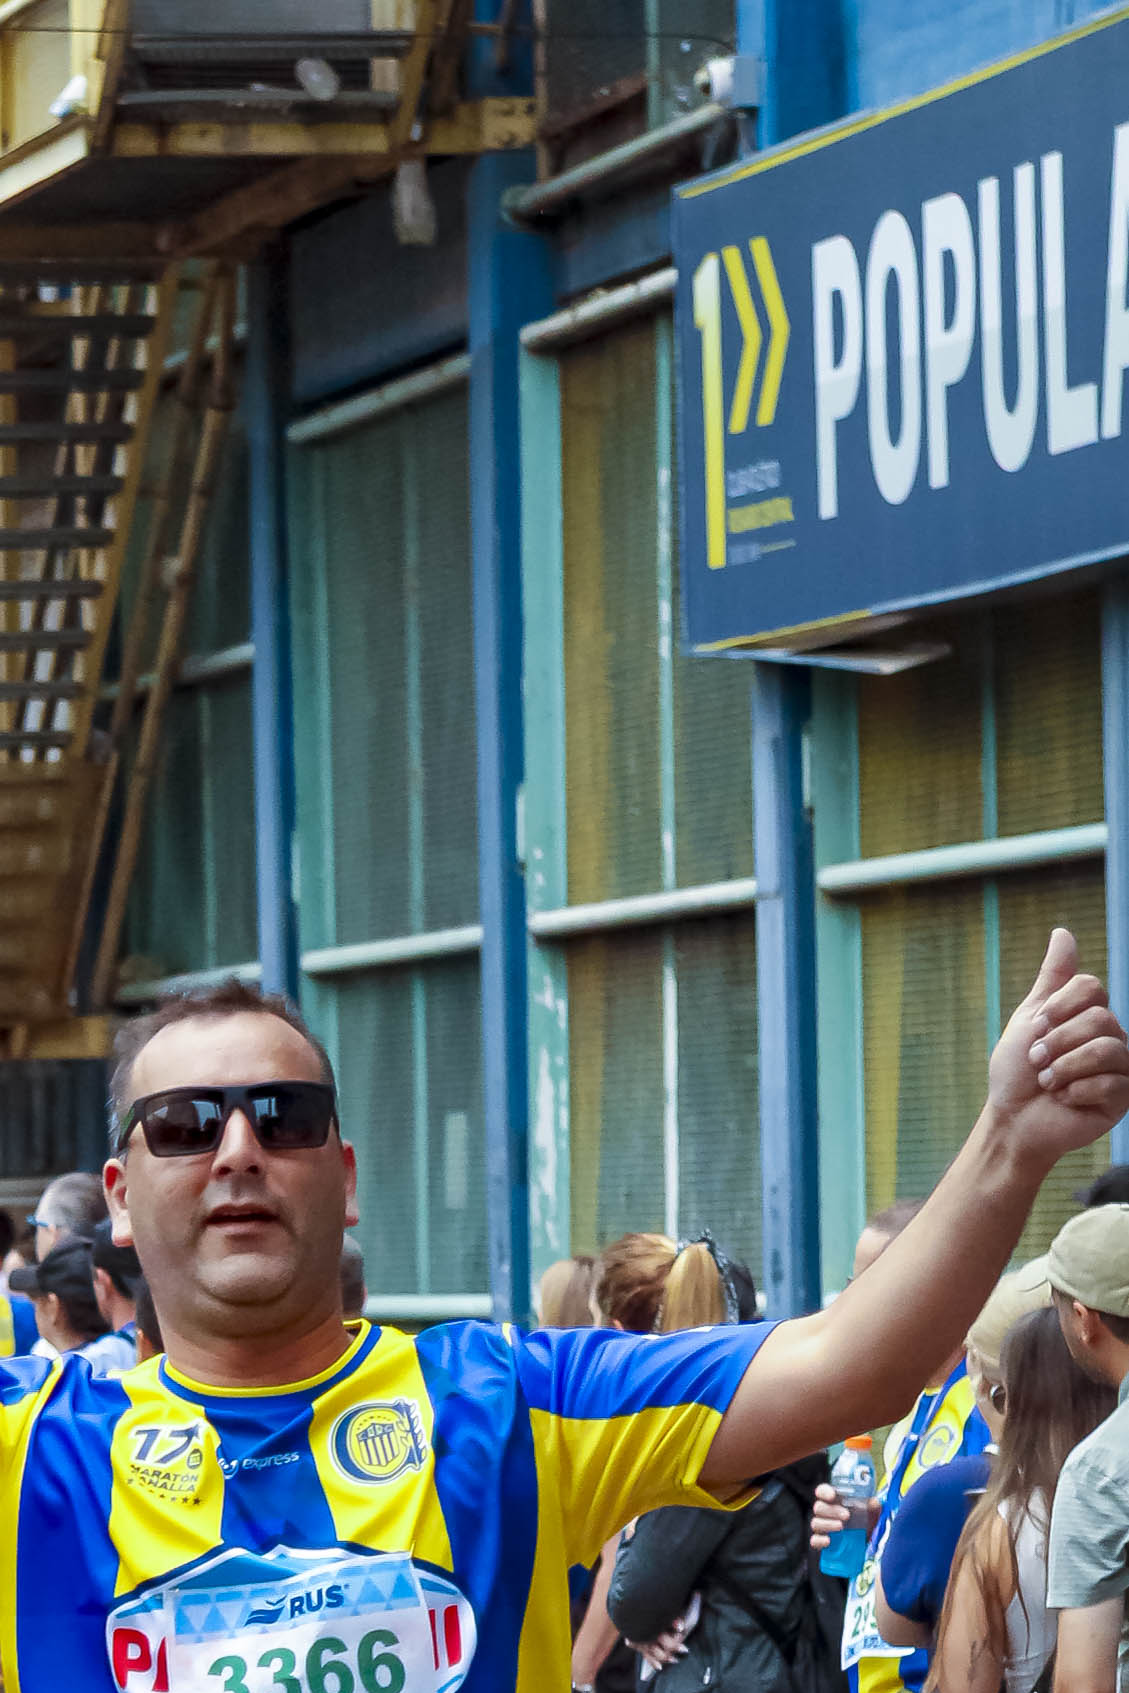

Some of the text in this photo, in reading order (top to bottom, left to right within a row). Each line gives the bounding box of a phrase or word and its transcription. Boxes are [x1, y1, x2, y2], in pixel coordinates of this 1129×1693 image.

[693, 252, 726, 570] 1
[135, 1424, 200, 1464] 17
[242, 1452, 299, 1471] express
[288, 1584, 345, 1620] RUS
